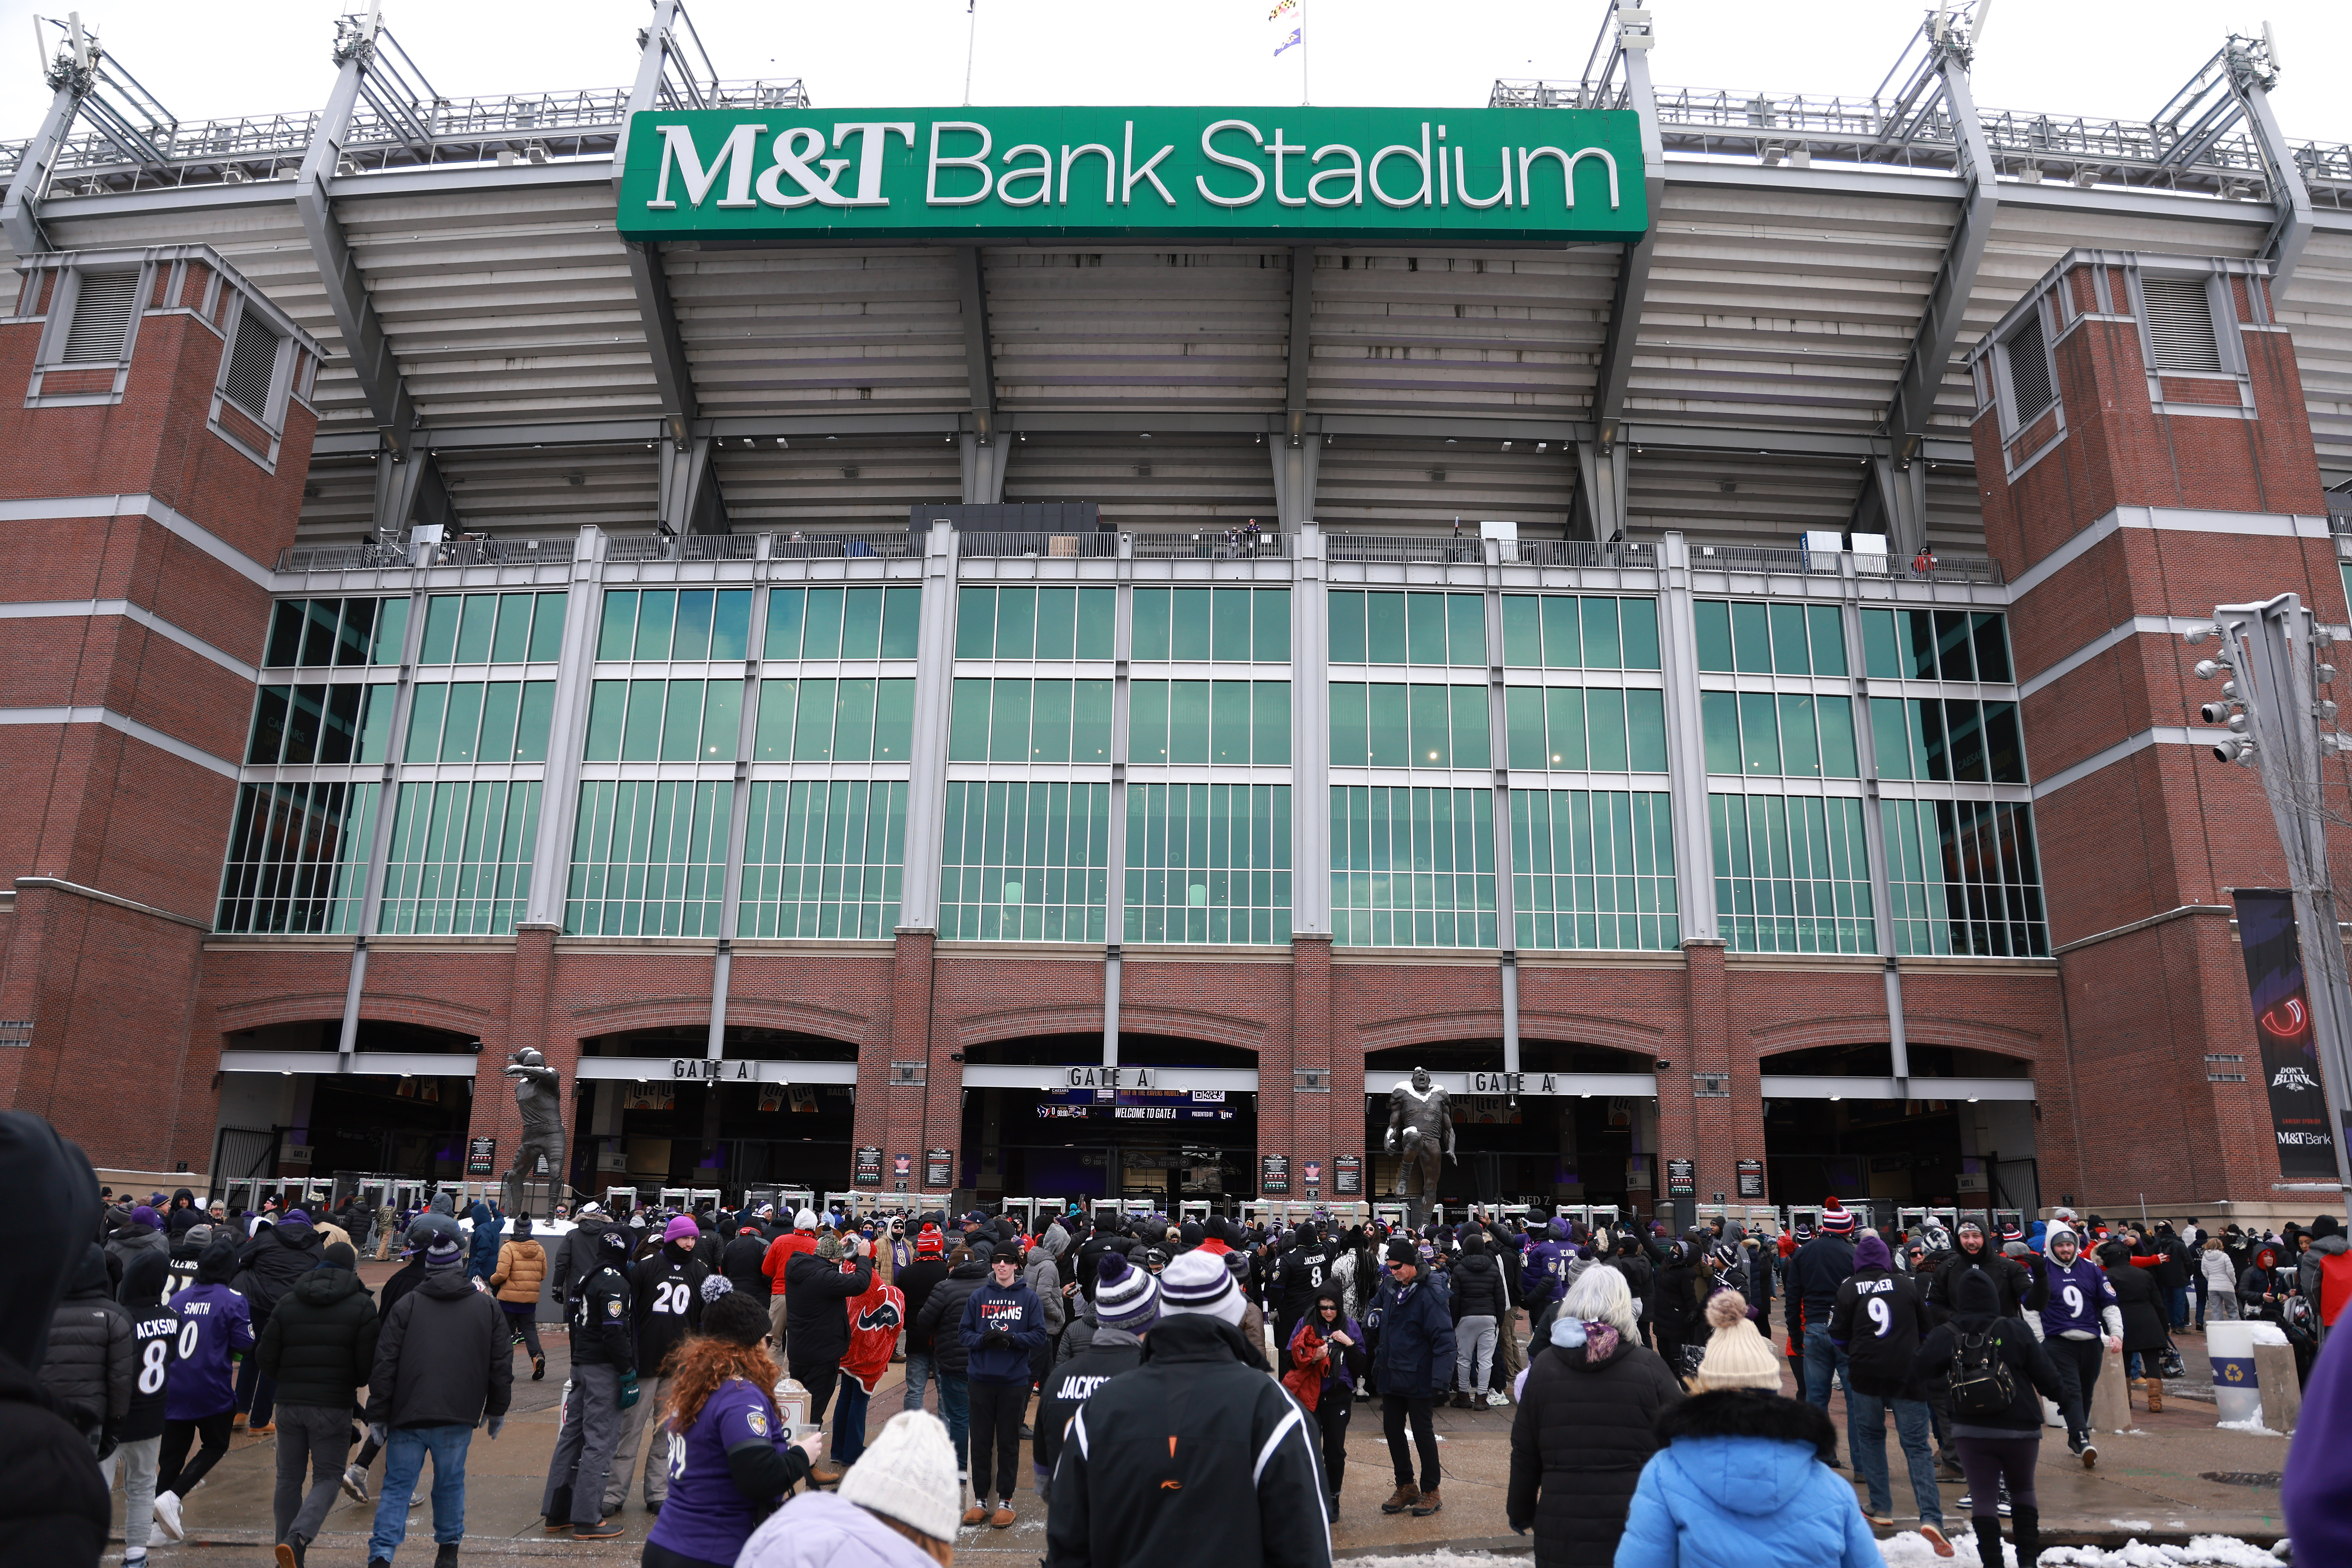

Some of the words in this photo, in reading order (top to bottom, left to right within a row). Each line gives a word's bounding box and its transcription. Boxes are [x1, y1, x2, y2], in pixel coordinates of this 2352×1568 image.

[646, 123, 915, 209] M&T
[926, 121, 1176, 208] Bank
[1196, 119, 1617, 210] Stadium
[268, 717, 305, 742] CAEARS
[674, 1060, 721, 1078] GATE
[737, 1060, 747, 1078] A
[1071, 1067, 1120, 1086] GATE
[1137, 1068, 1148, 1087] A
[1476, 1073, 1524, 1092] GATE
[1542, 1074, 1552, 1092] A
[2272, 1074, 2319, 1086] BLINK
[633, 1083, 655, 1099] Lite
[791, 1085, 812, 1102] Lite
[827, 1088, 849, 1096] BALTI
[1115, 1107, 1147, 1118] WELCOME
[1147, 1108, 1154, 1118] TO
[1155, 1108, 1171, 1118] GATE
[1171, 1109, 1176, 1118] A
[1476, 1096, 1499, 1113] Lite
[2277, 1132, 2305, 1145] M&T
[2306, 1132, 2332, 1145] Bank
[1519, 1196, 1541, 1205] RED
[897, 1249, 906, 1267] 8
[1303, 1254, 1326, 1265] JACKSON
[1311, 1266, 1322, 1288] 8
[1558, 1260, 1573, 1281] 4
[1856, 1278, 1893, 1295] TUKER
[652, 1281, 691, 1315] 20
[2062, 1285, 2084, 1318] 9
[184, 1301, 211, 1315] SMITH
[981, 1305, 1022, 1320] TEXANS
[1867, 1297, 1891, 1338] 9
[136, 1318, 178, 1339] ACKSON
[178, 1320, 198, 1360] 0
[138, 1339, 167, 1395] 8
